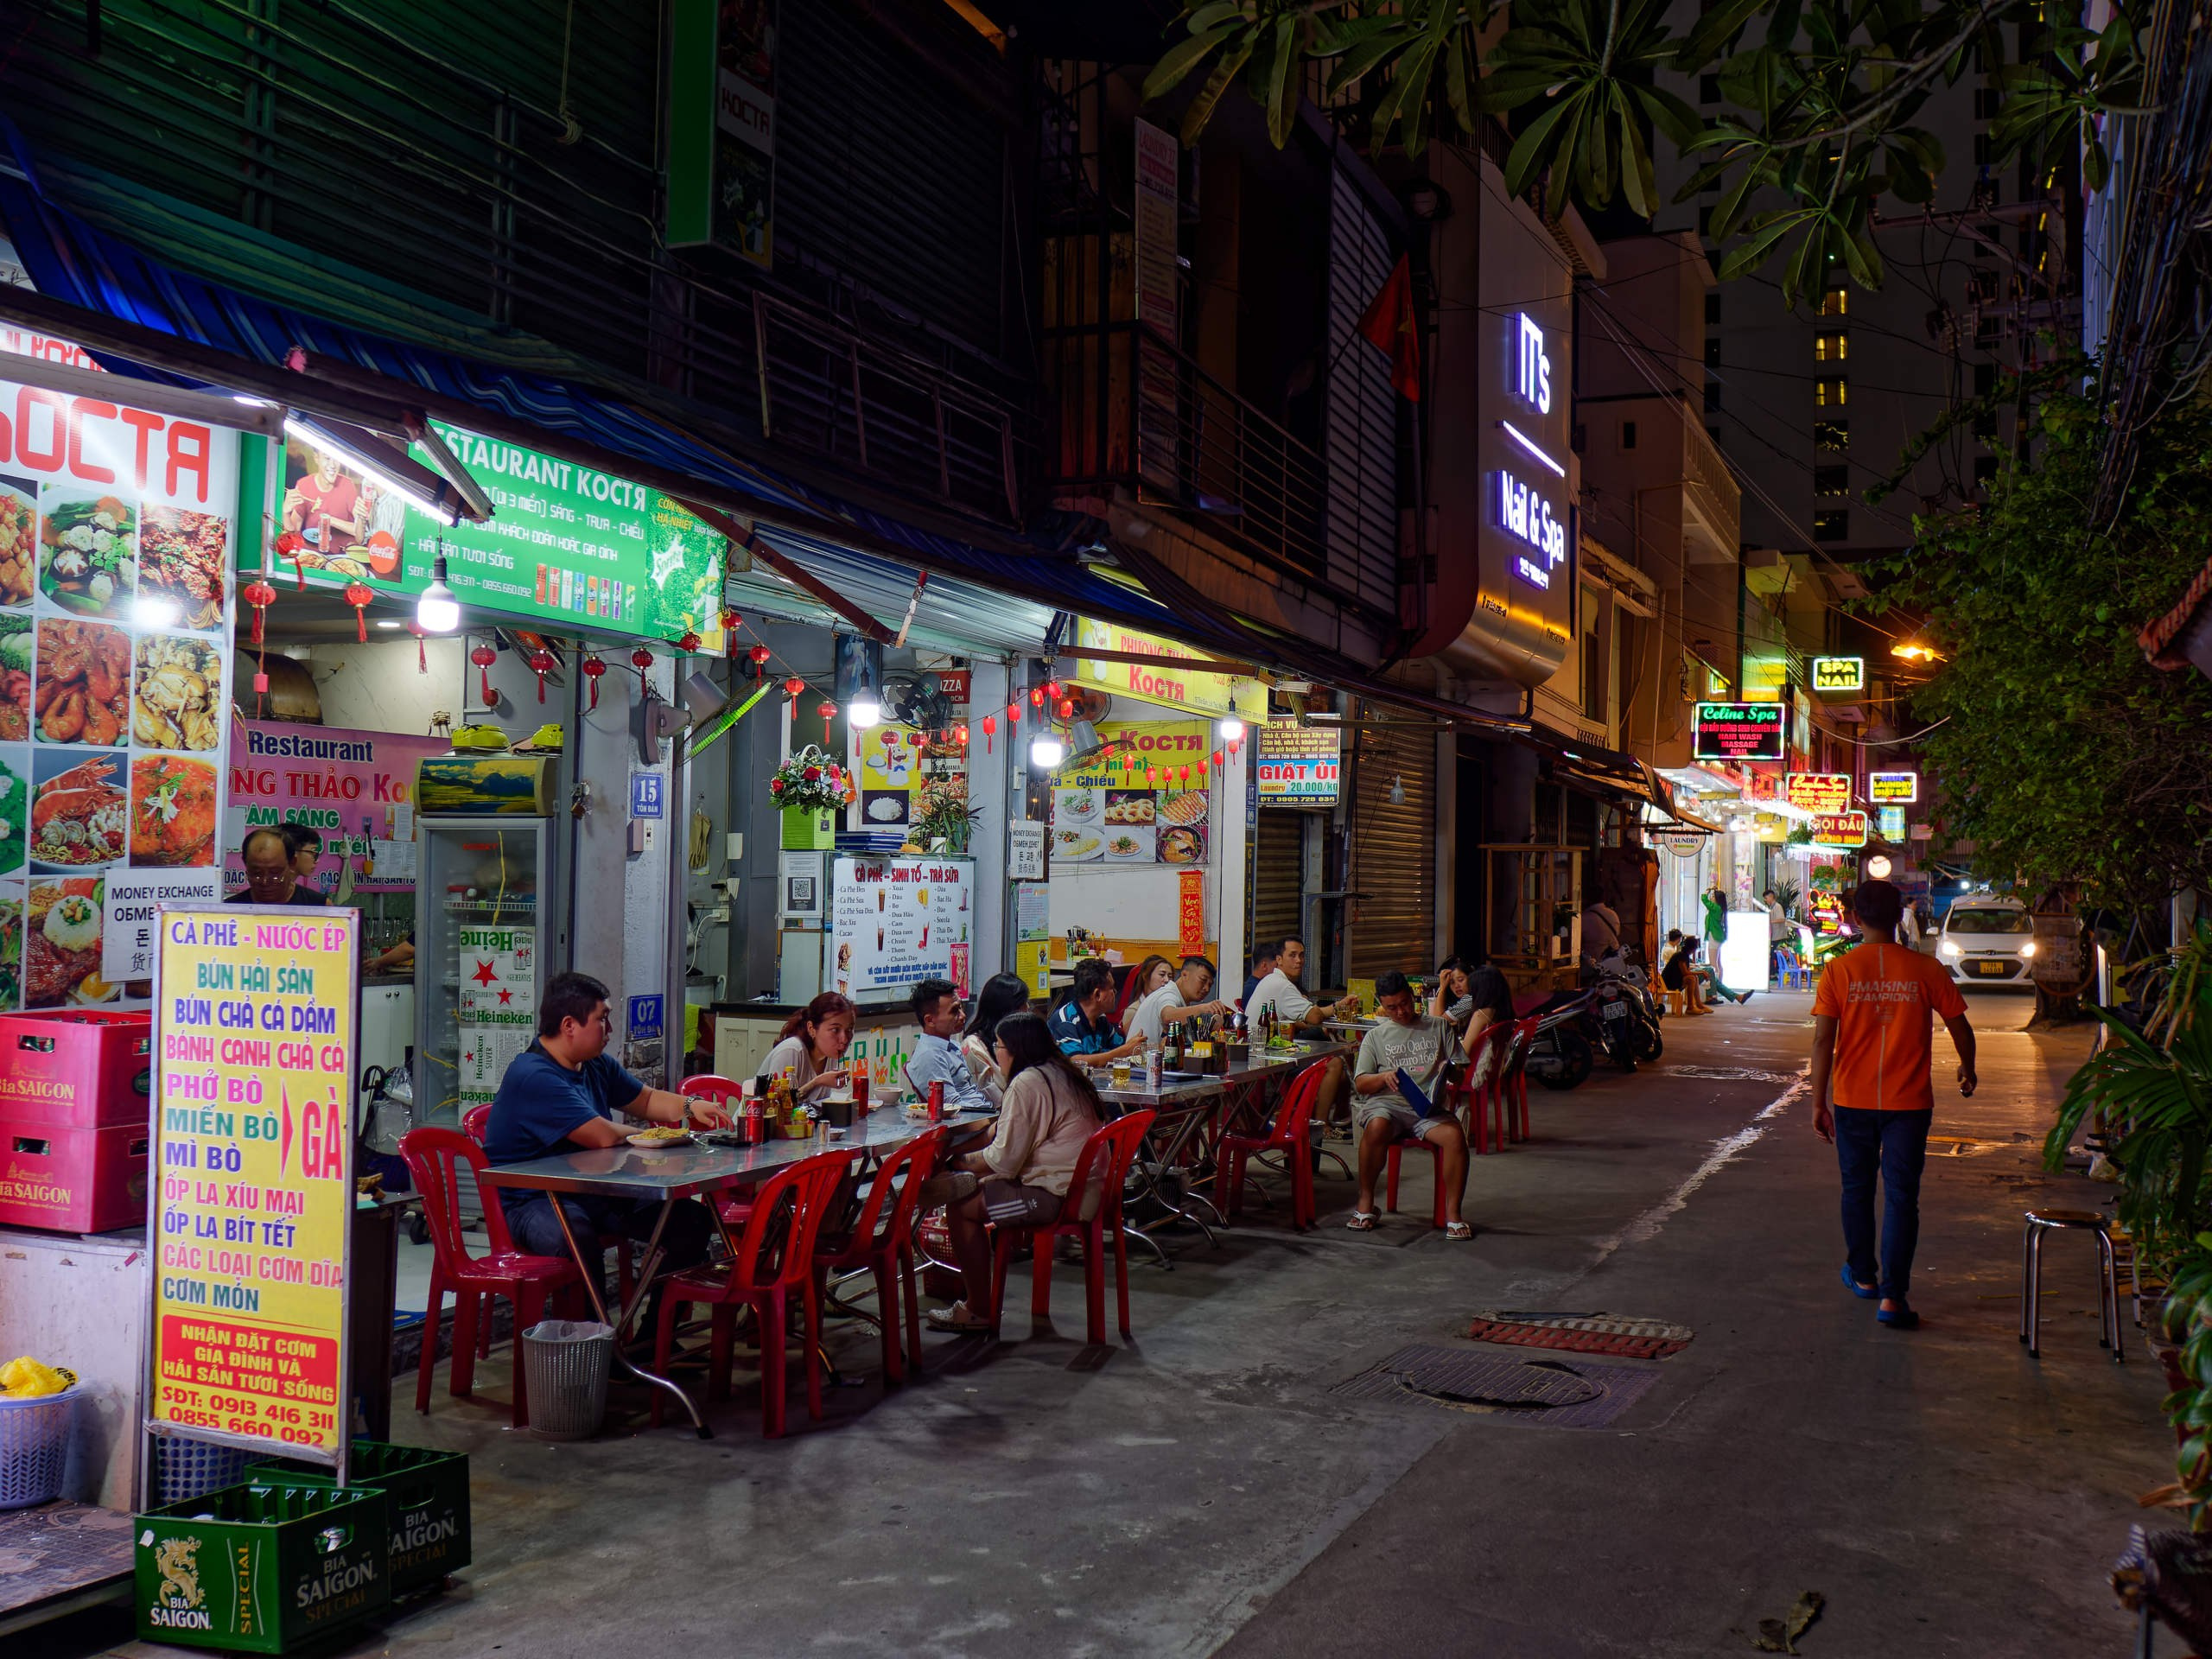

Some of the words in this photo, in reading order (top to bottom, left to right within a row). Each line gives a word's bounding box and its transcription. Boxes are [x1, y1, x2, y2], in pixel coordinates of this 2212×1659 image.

[1502, 470, 1528, 541] Nail
[1530, 491, 1540, 547] &
[1541, 500, 1565, 570] Spa
[1817, 674, 1859, 686] NAIL
[1821, 662, 1856, 674] SPA
[1703, 707, 1745, 720] Celine
[1747, 707, 1777, 723] Spa
[247, 730, 374, 763] Restaurant
[1120, 730, 1204, 751] Костя
[286, 766, 362, 801] THẢO
[1076, 773, 1116, 787] Chiều
[1259, 762, 1307, 783] GIẶT
[1316, 761, 1338, 779] ỦI
[639, 779, 657, 803] 15
[286, 805, 340, 829] SÁNG
[1839, 815, 1864, 831] ĐẦU
[891, 868, 908, 883] SINH
[111, 887, 155, 899] MONEY
[158, 886, 213, 898] EXCHANGE
[115, 907, 155, 921] ОБМЕ
[172, 916, 197, 947] CÀ
[203, 919, 238, 947] PHÊ
[256, 921, 318, 951] NƯỚC
[322, 922, 346, 952] ÉP
[197, 957, 234, 991] BÚN
[239, 958, 270, 994] HẢI
[276, 960, 314, 995] SẢN
[1848, 981, 1919, 993] #MAKING
[175, 993, 212, 1026] BÚN
[218, 995, 254, 1029] CHẢ
[260, 999, 284, 1032] CÁ
[637, 1000, 656, 1023] 07
[1847, 993, 1918, 1003] CHAMPIONS
[477, 1009, 533, 1025] Heineken
[166, 1028, 214, 1064] BÁNH
[220, 1038, 270, 1068] CANH
[276, 1036, 314, 1072] CHẢ
[321, 1040, 344, 1073] CÁ
[17, 1079, 75, 1100] SAIGON
[166, 1069, 219, 1101] PHỞ
[227, 1074, 263, 1105] BÒ
[166, 1103, 233, 1137] MIẾN
[243, 1110, 279, 1141] BÒ
[302, 1086, 343, 1181] GÀ
[165, 1139, 197, 1167] MÌ
[207, 1142, 242, 1173] BÒ
[14, 1183, 72, 1205] SAIGON
[164, 1170, 190, 1202] ỐP
[195, 1180, 219, 1206] LA
[225, 1180, 259, 1211] XÍU
[265, 1189, 304, 1219] MẠI
[164, 1205, 189, 1235] ỐP
[195, 1214, 219, 1240] LA
[225, 1214, 257, 1243] BÍT
[262, 1217, 296, 1249] TẾT
[163, 1241, 202, 1270] CÁC
[208, 1250, 251, 1281] LOẠI
[258, 1255, 303, 1284] CƠM
[310, 1260, 342, 1288] DĨA
[163, 1277, 207, 1305] CƠM
[213, 1282, 259, 1313] MÓN
[181, 1324, 231, 1351] NHẬN
[236, 1332, 269, 1354] ĐẶT
[275, 1338, 316, 1358] CƠM
[194, 1346, 224, 1365] GIA
[229, 1349, 272, 1370] ĐÌNH
[278, 1357, 301, 1377] VÀ
[163, 1358, 192, 1380] HẢI
[197, 1364, 233, 1387] SẢN
[238, 1370, 278, 1394] TƯƠI
[283, 1377, 334, 1403] SỐNG
[162, 1386, 203, 1408] SĐT:
[209, 1395, 257, 1416] 0913
[264, 1404, 302, 1427] 416
[308, 1410, 334, 1430] 311
[168, 1406, 221, 1429] 0855
[228, 1417, 273, 1439] 660
[280, 1426, 324, 1449] 092
[404, 1510, 429, 1529] BIA
[387, 1516, 457, 1556] AIGON
[323, 1555, 348, 1575] BIA
[238, 1541, 252, 1635] SPECIAL
[296, 1559, 374, 1609] SAIGON
[149, 1607, 211, 1630] SAIGON
[169, 1597, 190, 1611] BIA
